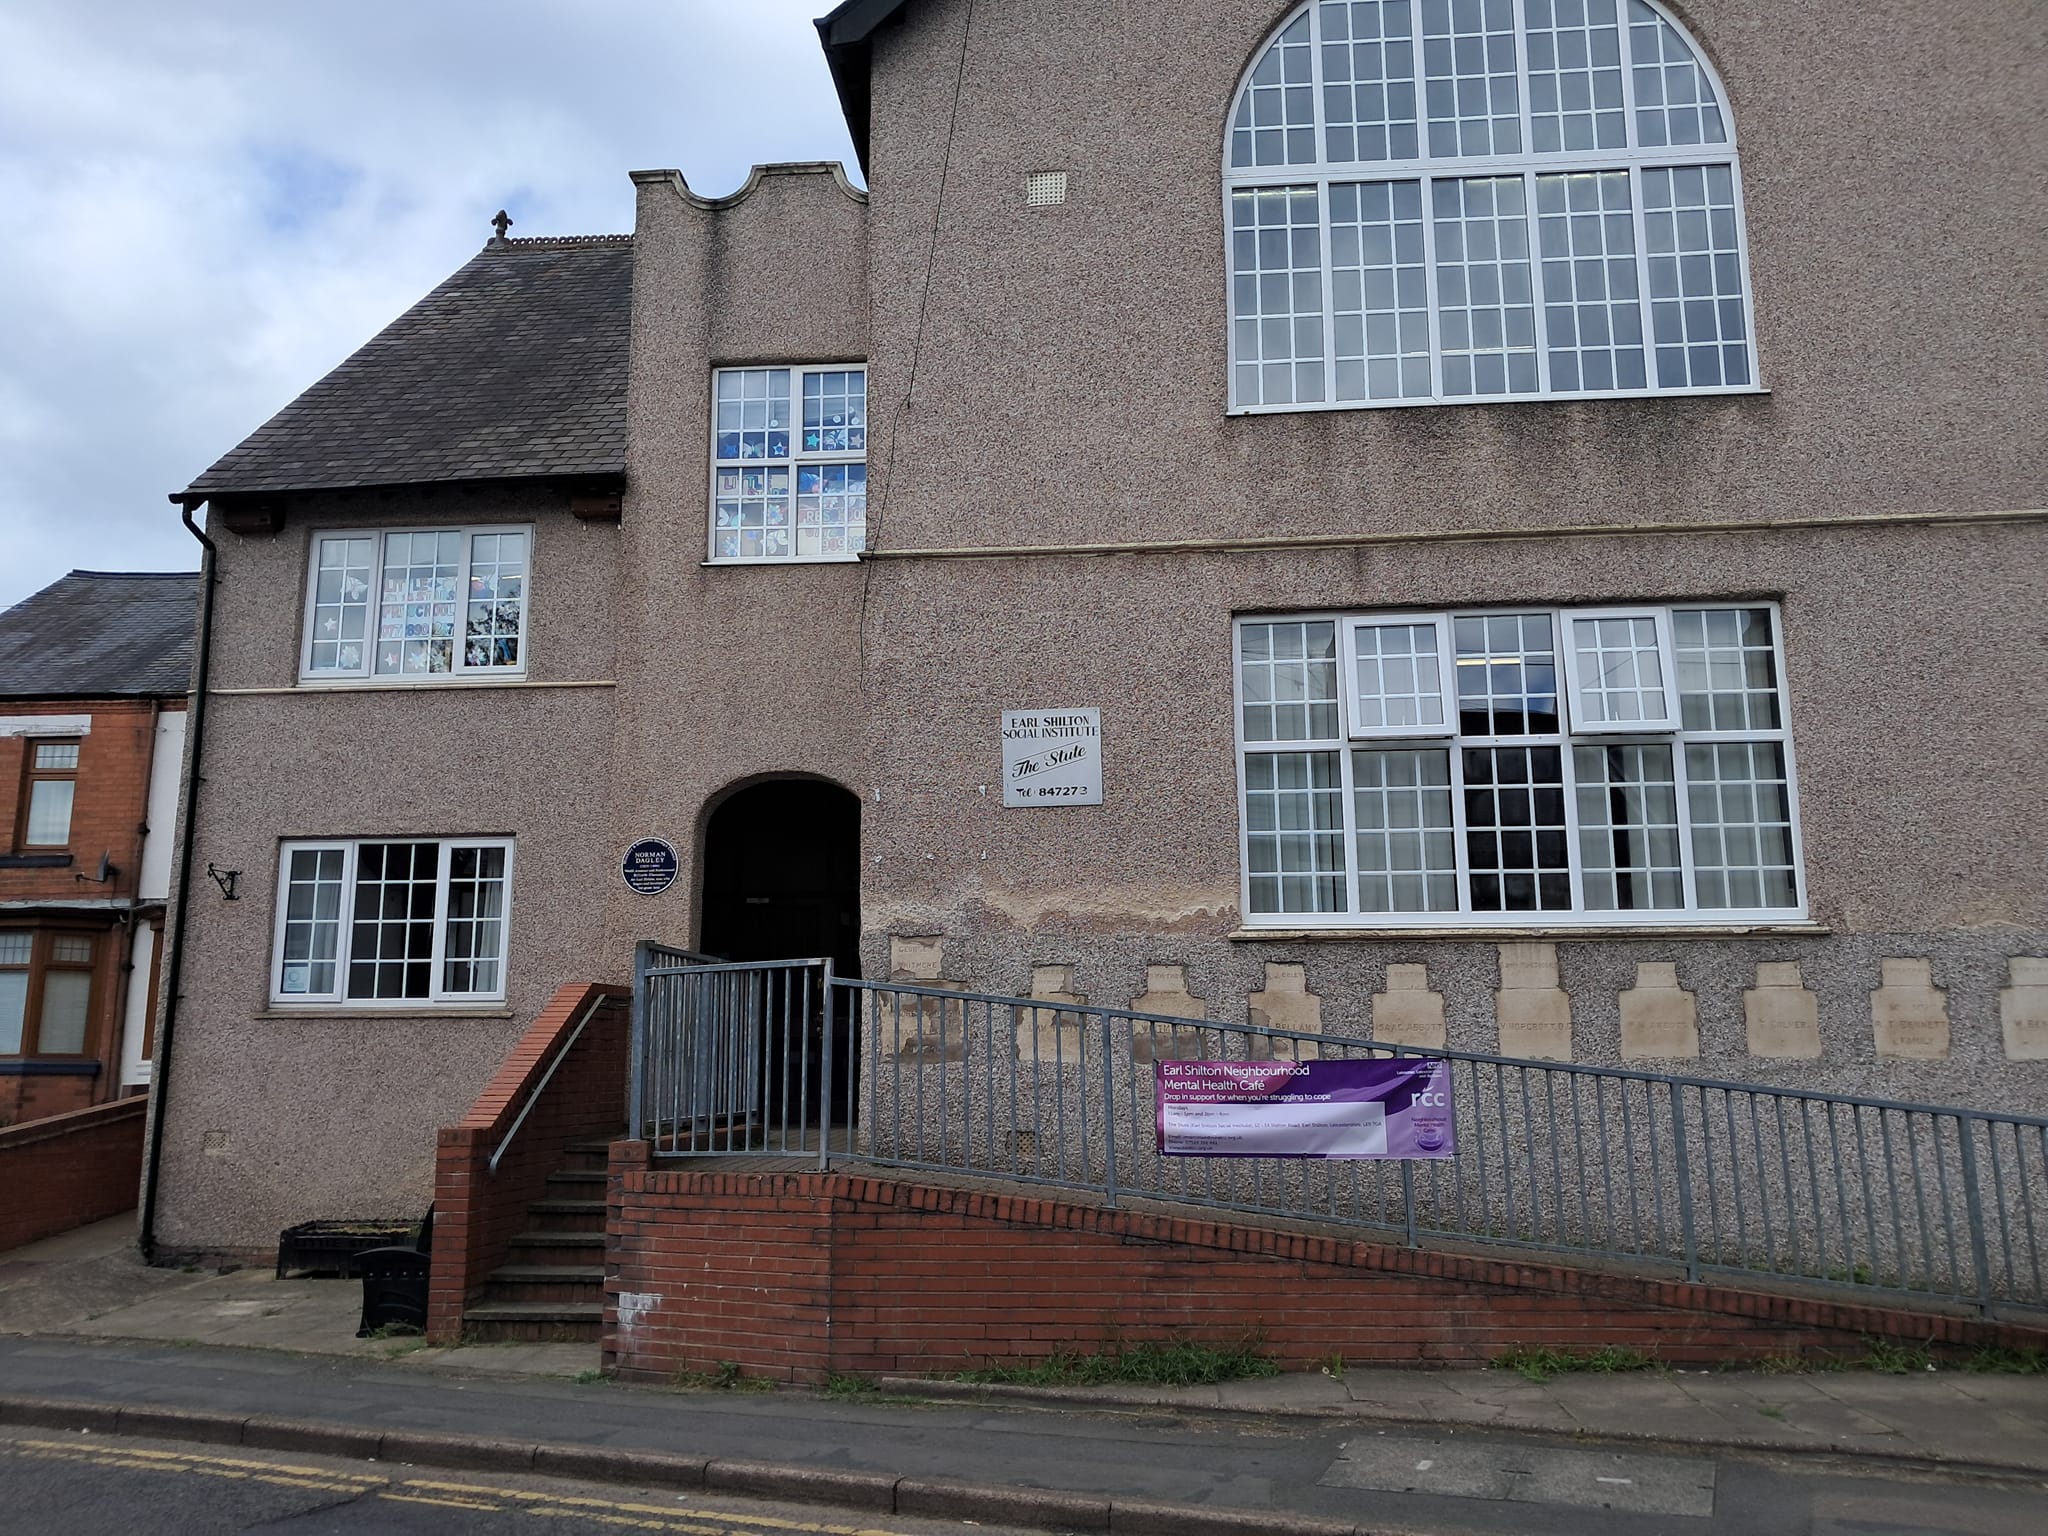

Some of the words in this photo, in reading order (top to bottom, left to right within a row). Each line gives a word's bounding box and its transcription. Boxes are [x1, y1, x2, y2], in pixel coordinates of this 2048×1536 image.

[1011, 717, 1040, 728] EARL
[1043, 715, 1090, 727] SHILTON
[1003, 728, 1040, 740] SOCIAL
[1042, 726, 1099, 738] INSTITUTE
[1011, 759, 1040, 778] The
[1043, 744, 1087, 767] Stute
[1038, 786, 1088, 797] 847273
[1163, 1065, 1183, 1076] Earl
[1185, 1065, 1222, 1076] Shilton
[1224, 1065, 1310, 1079] Neighbourhood
[1164, 1079, 1201, 1090] Mental
[1202, 1080, 1238, 1090] Health
[1239, 1079, 1265, 1091] Café
[1163, 1093, 1181, 1101] Drop
[1189, 1094, 1215, 1102] support
[1247, 1094, 1269, 1102] you're
[1269, 1093, 1304, 1102] struggling
